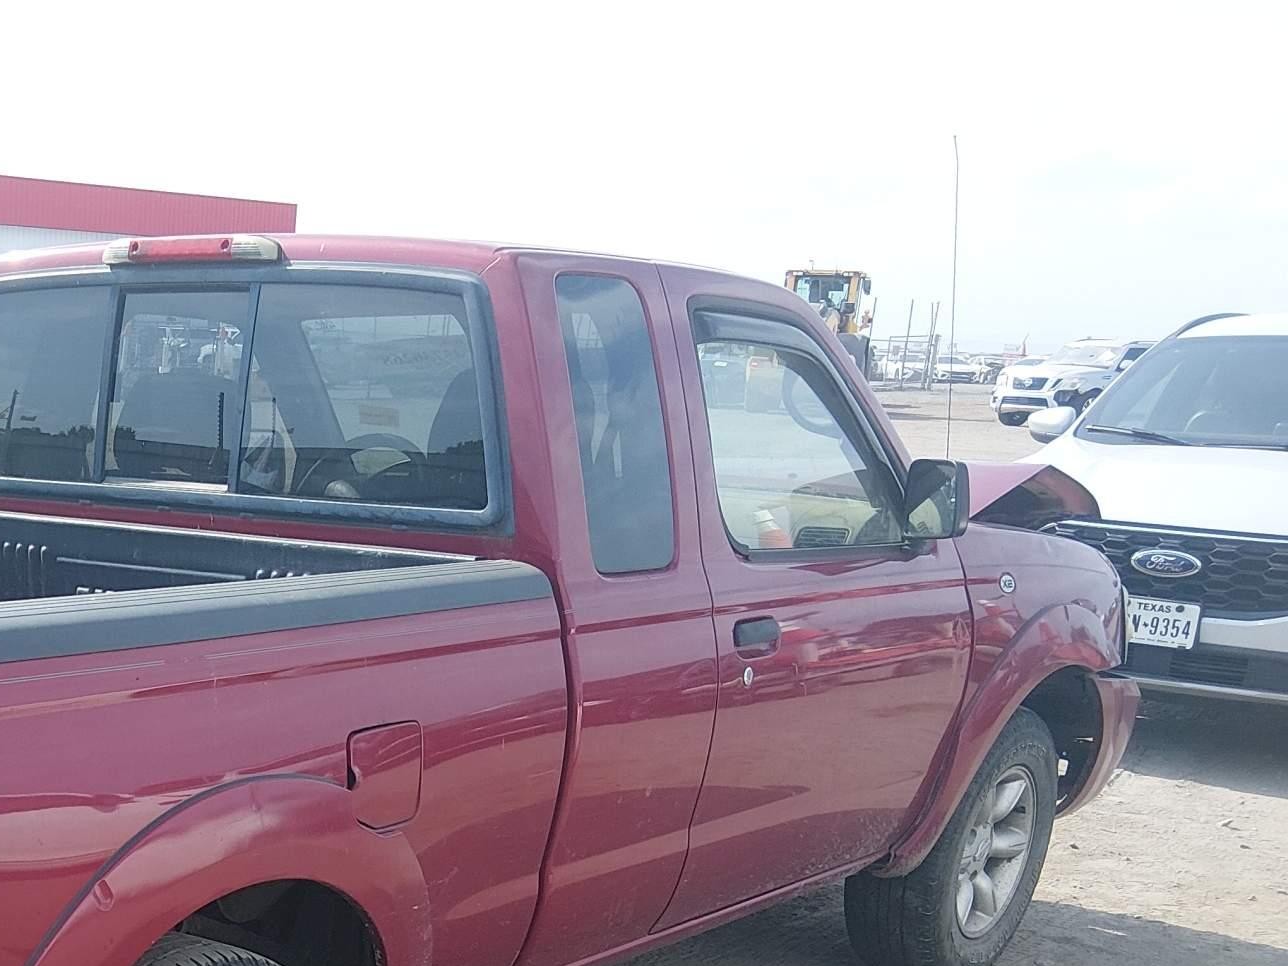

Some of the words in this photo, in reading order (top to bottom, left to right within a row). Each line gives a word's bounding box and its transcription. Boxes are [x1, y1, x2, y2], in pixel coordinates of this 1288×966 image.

[1146, 554, 1185, 572] Ford
[1002, 579, 1013, 588] XE
[1137, 602, 1172, 613] TEXAS
